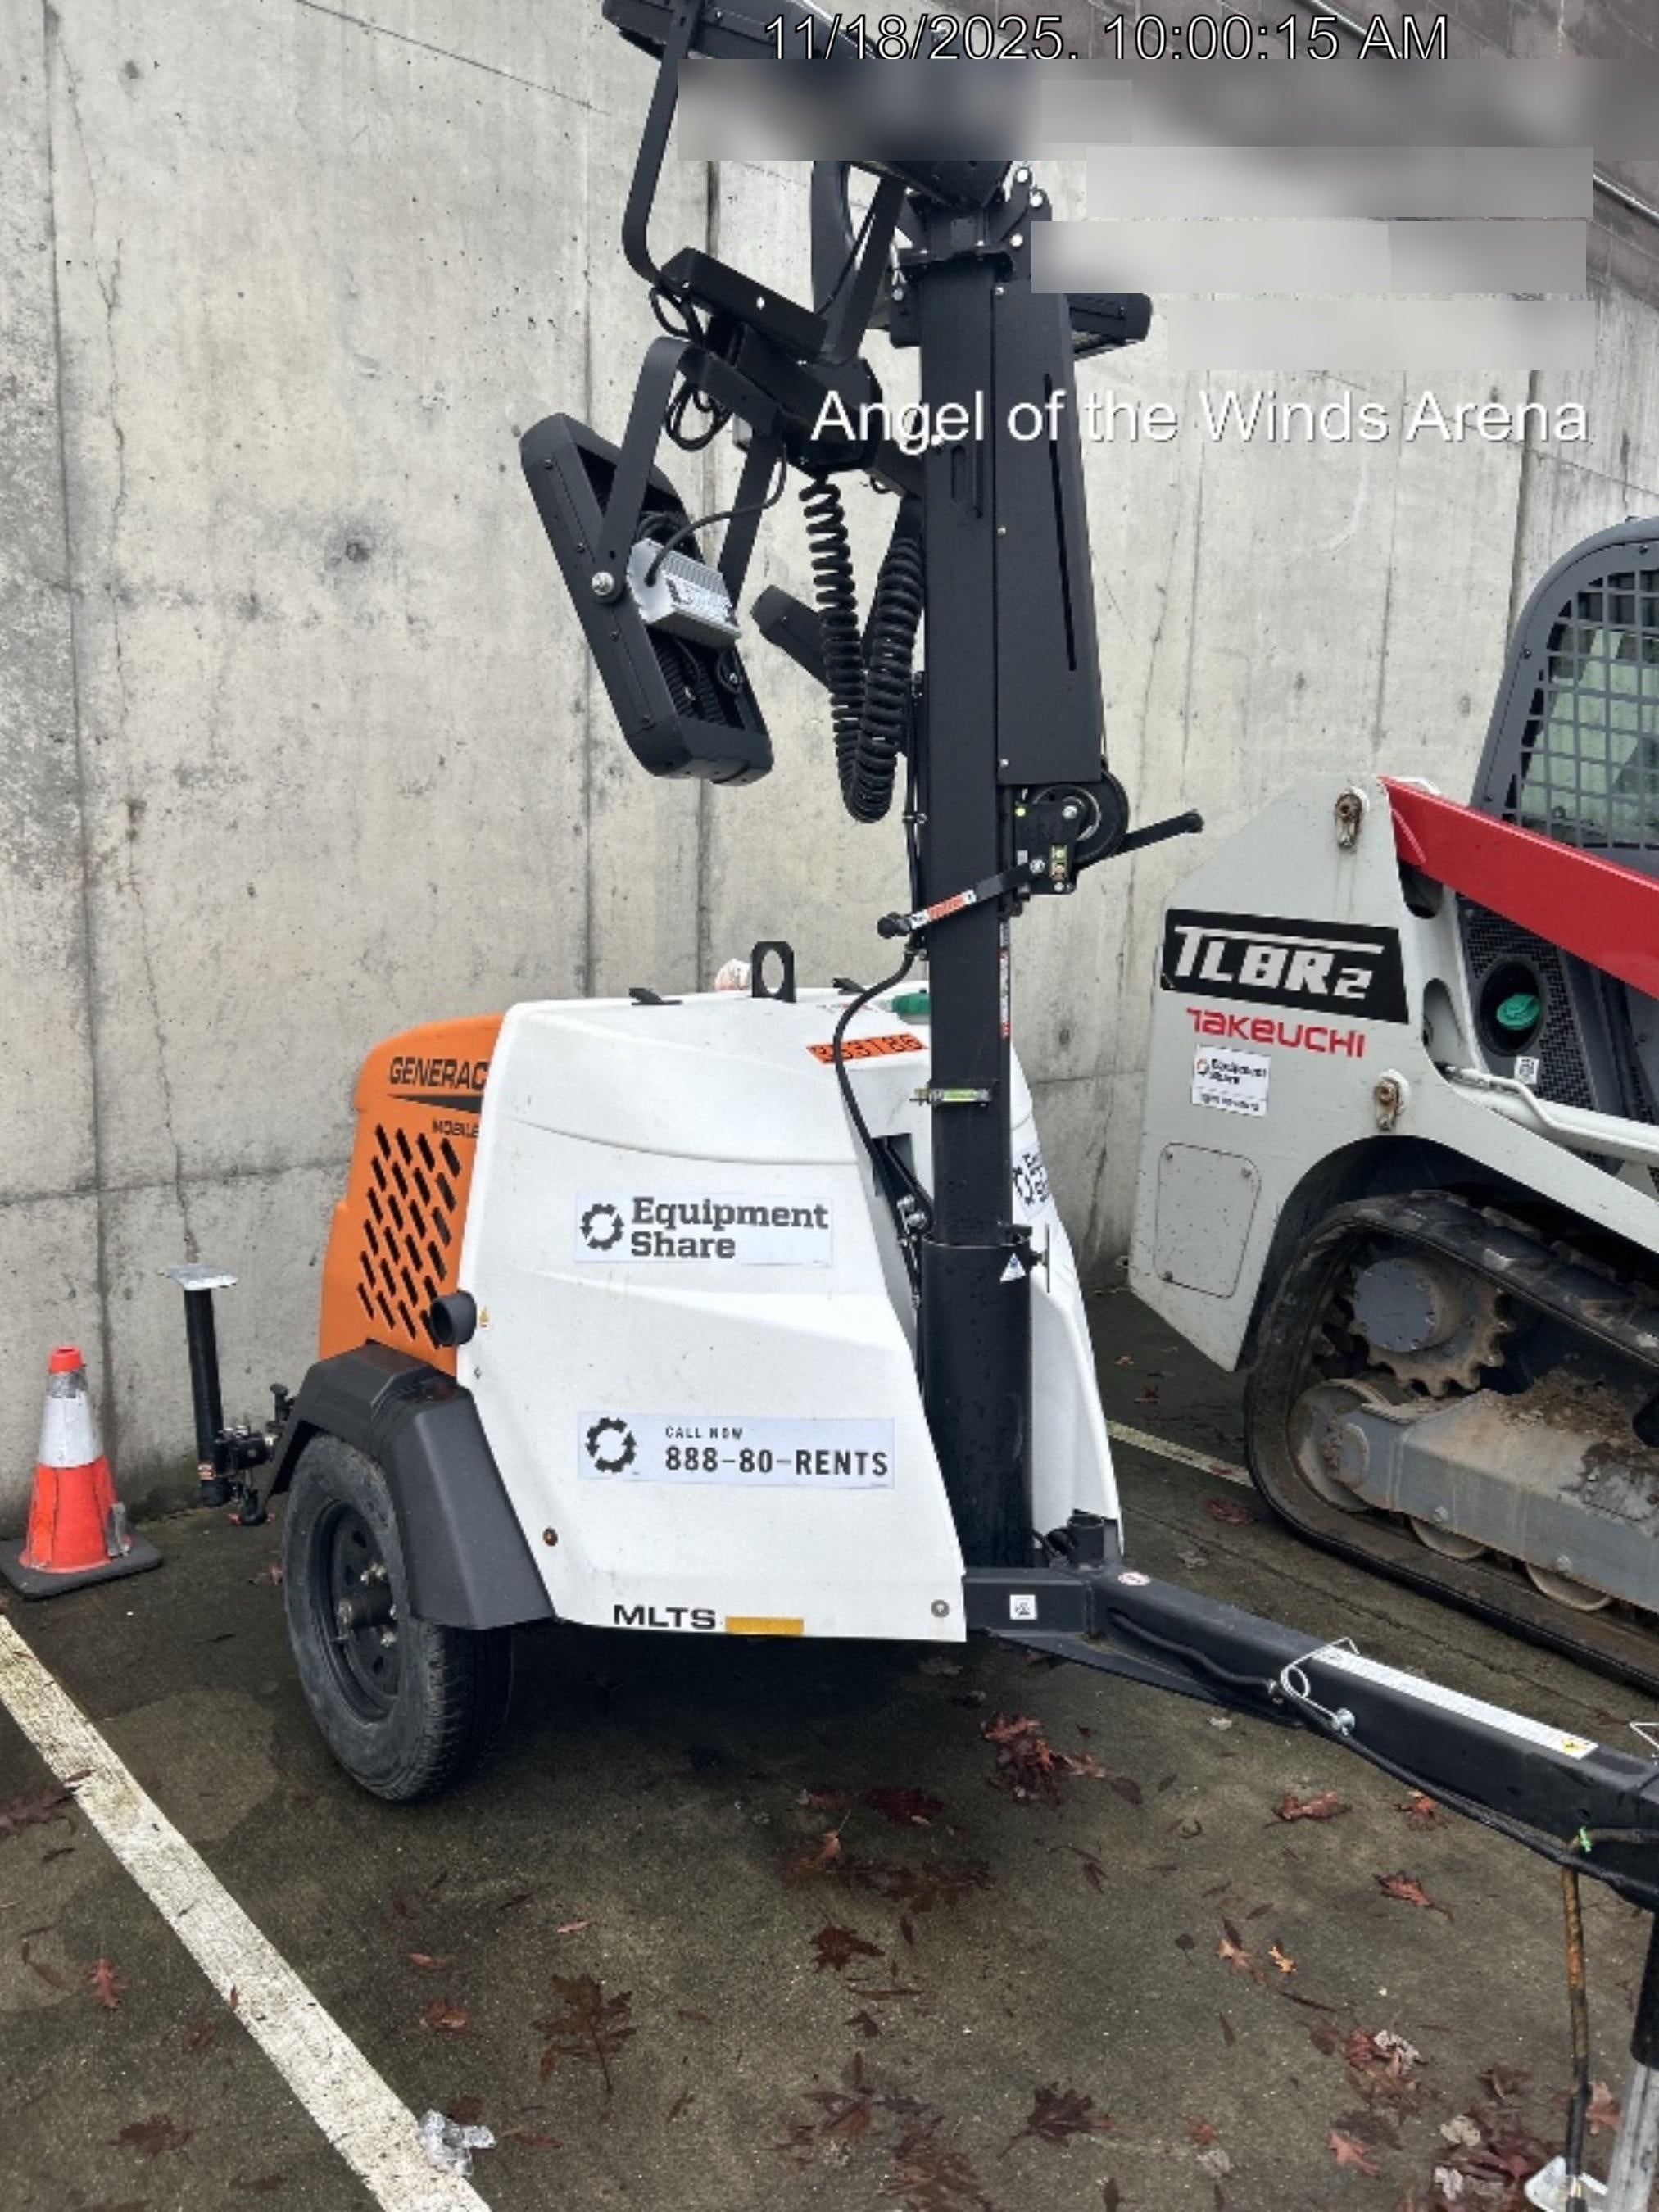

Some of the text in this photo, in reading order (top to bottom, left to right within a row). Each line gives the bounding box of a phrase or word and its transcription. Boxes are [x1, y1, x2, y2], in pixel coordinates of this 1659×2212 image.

[389, 1056, 491, 1090] GENERAC
[632, 1196, 828, 1231] Equipment
[631, 1231, 736, 1258] Share
[665, 1426, 743, 1440] CALL NOW
[665, 1445, 888, 1477] 888-80-RENTS
[613, 1604, 716, 1630] MLTS
